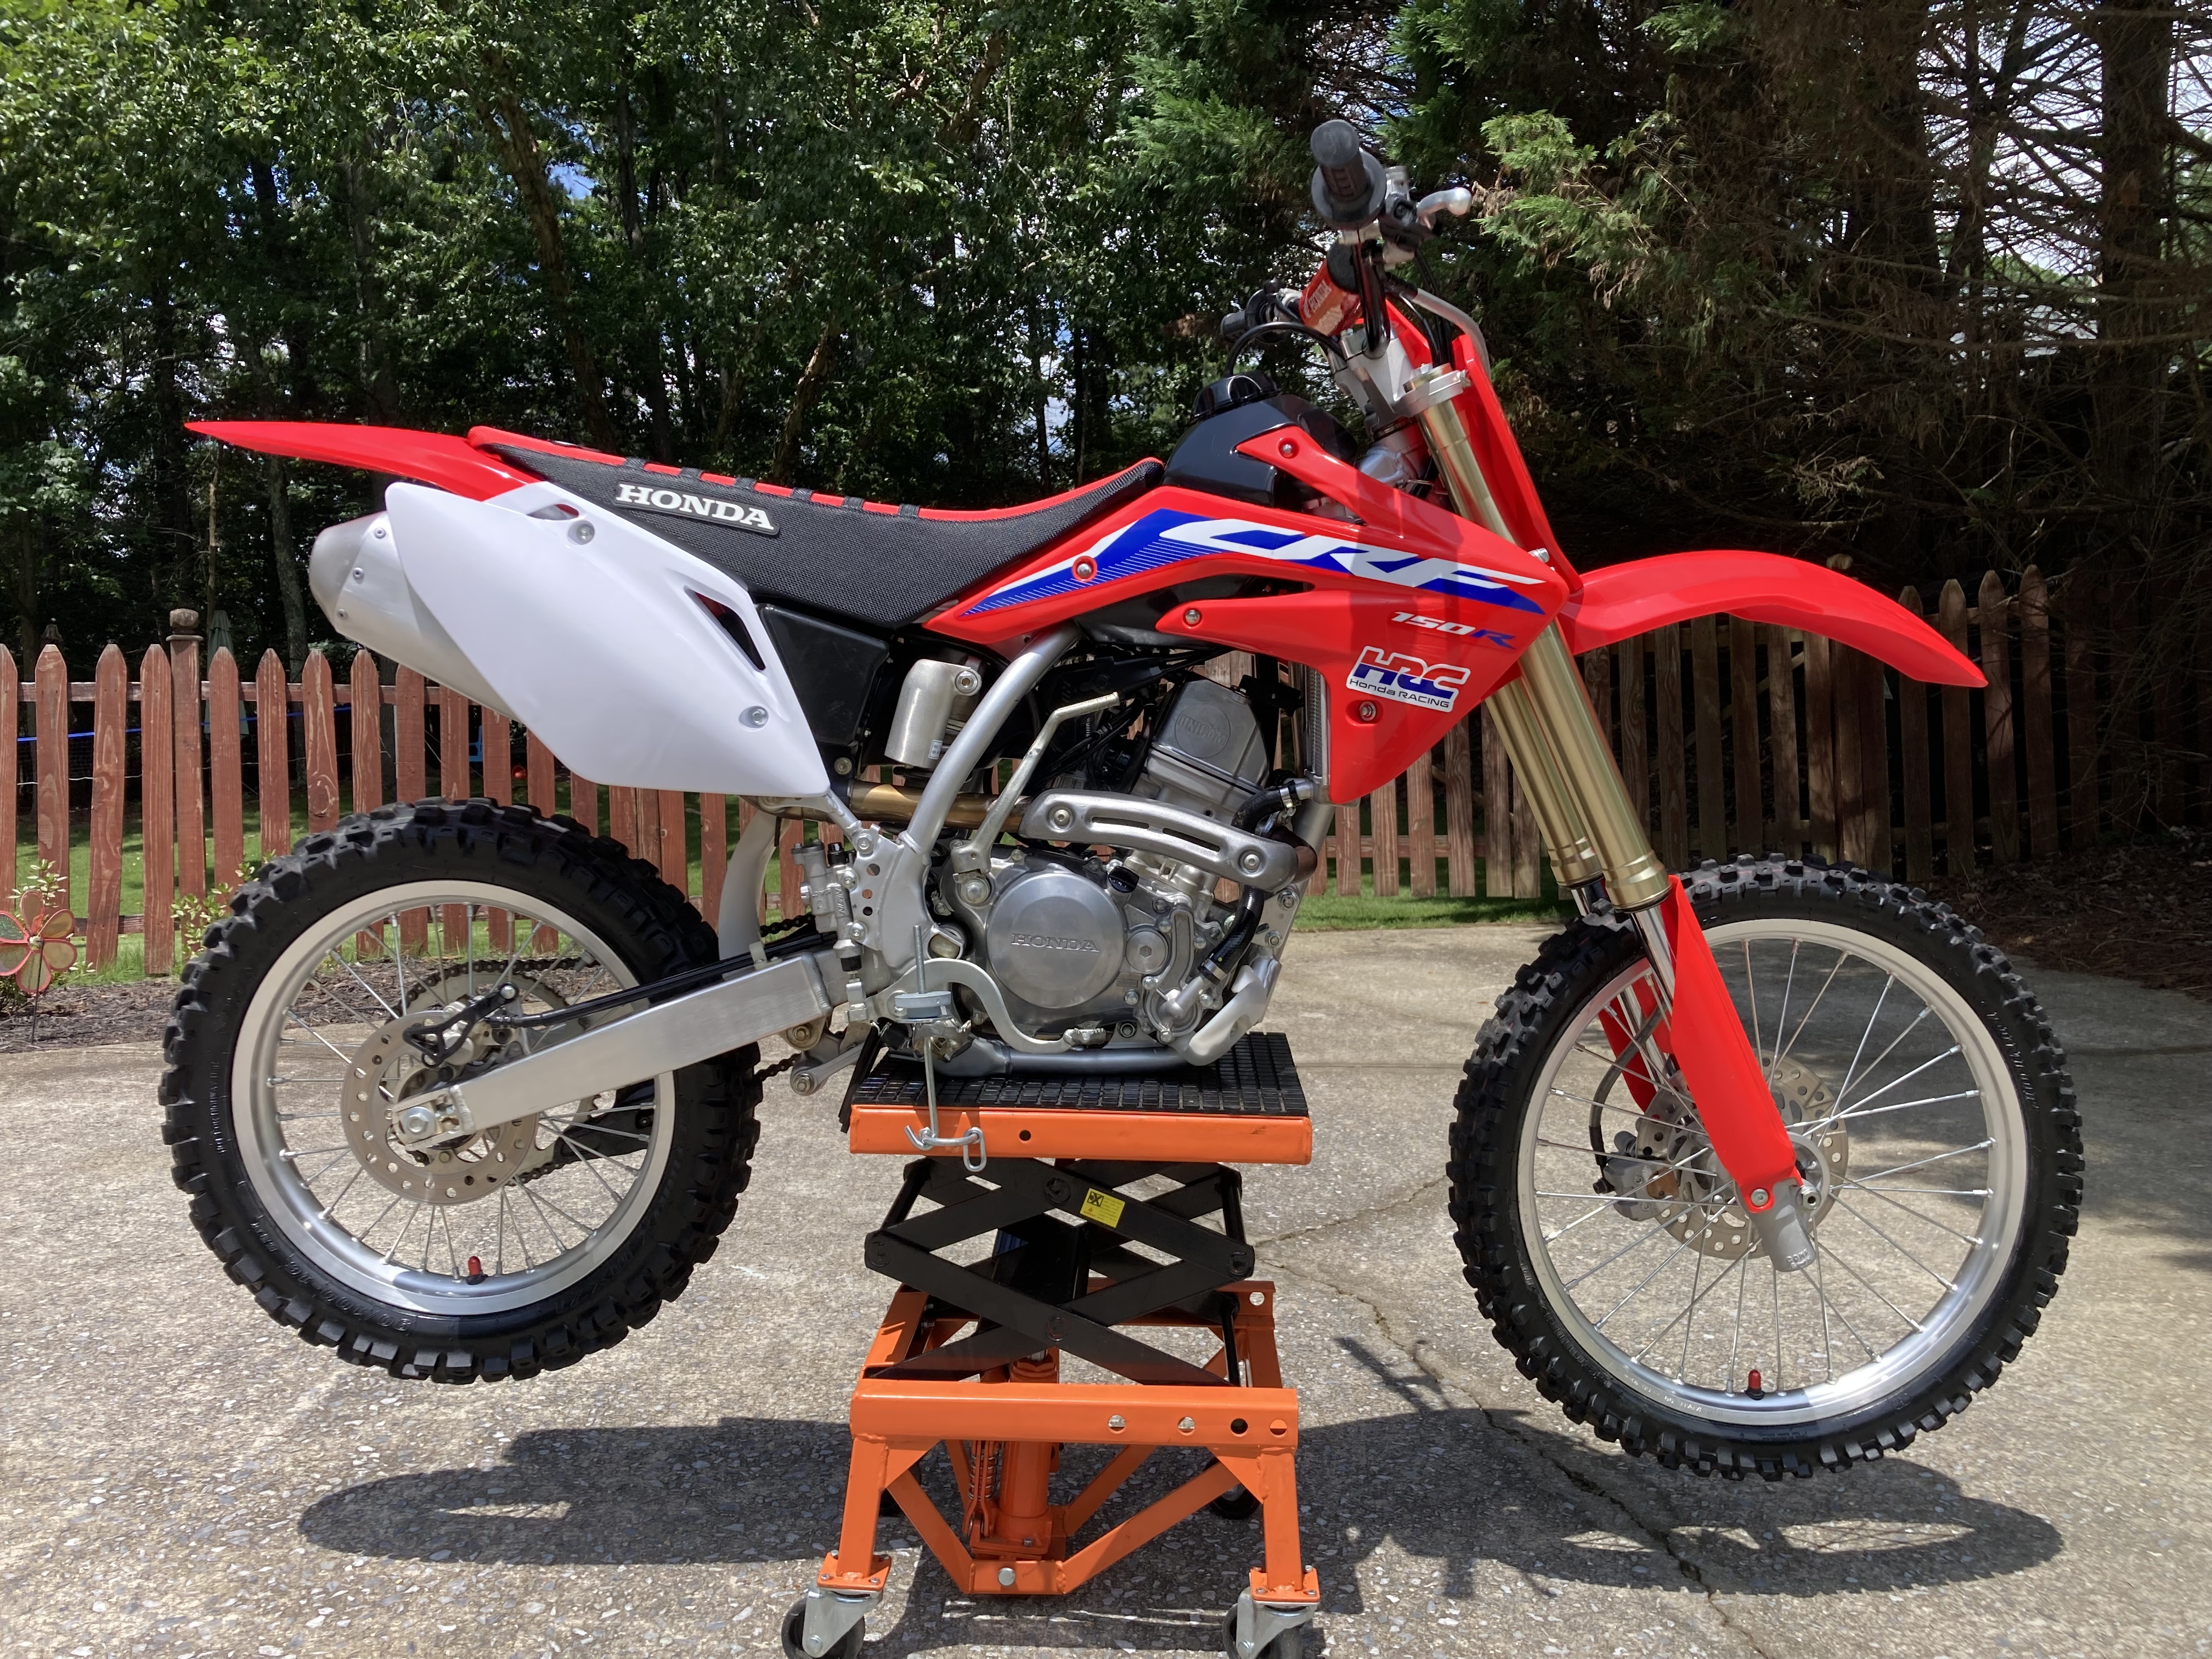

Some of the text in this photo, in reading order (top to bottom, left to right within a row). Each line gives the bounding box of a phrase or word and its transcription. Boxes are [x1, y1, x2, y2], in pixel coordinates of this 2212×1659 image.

[616, 483, 774, 531] HONDA
[1159, 518, 1546, 589] CRF
[1391, 611, 1517, 650] 150R
[1350, 678, 1450, 708] Honda RACING
[1352, 647, 1469, 700] HRC
[1178, 713, 1228, 746] UNICAM
[1011, 933, 1099, 952] HONDA
